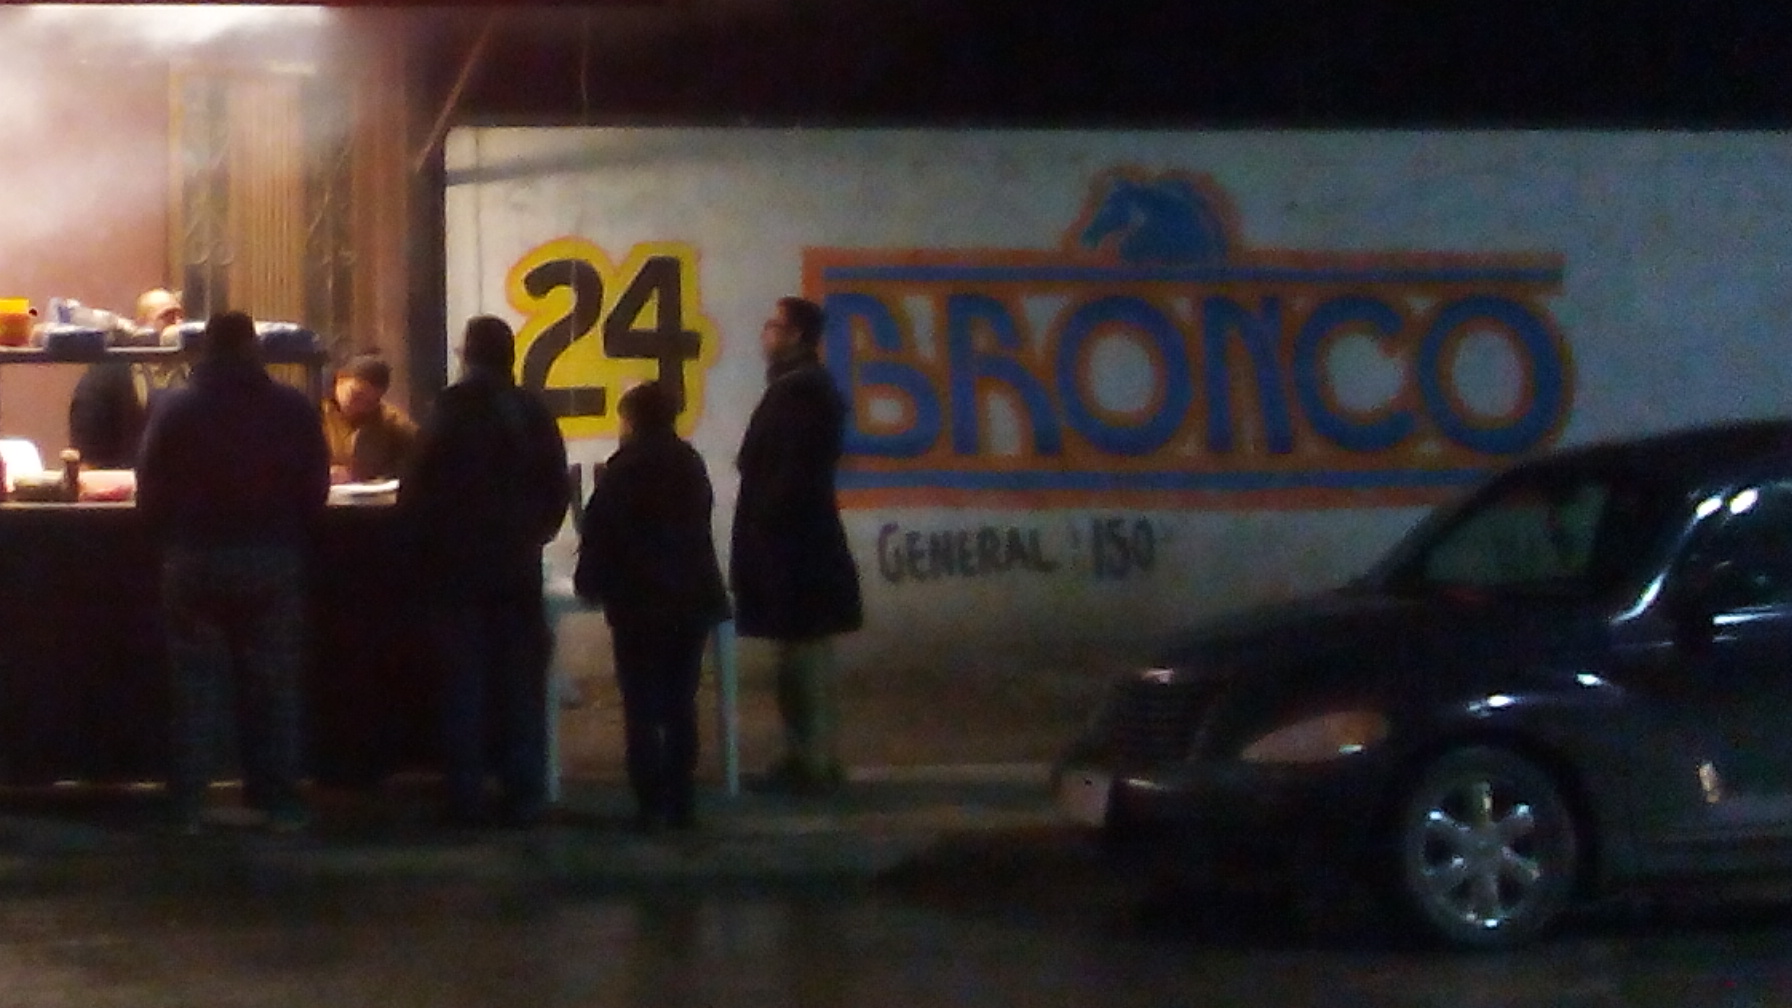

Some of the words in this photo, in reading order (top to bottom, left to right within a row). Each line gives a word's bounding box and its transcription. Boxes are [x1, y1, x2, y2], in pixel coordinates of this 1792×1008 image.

[522, 256, 701, 417] 24
[822, 291, 1565, 458] BRONCO
[877, 520, 1059, 584] GENERAL
